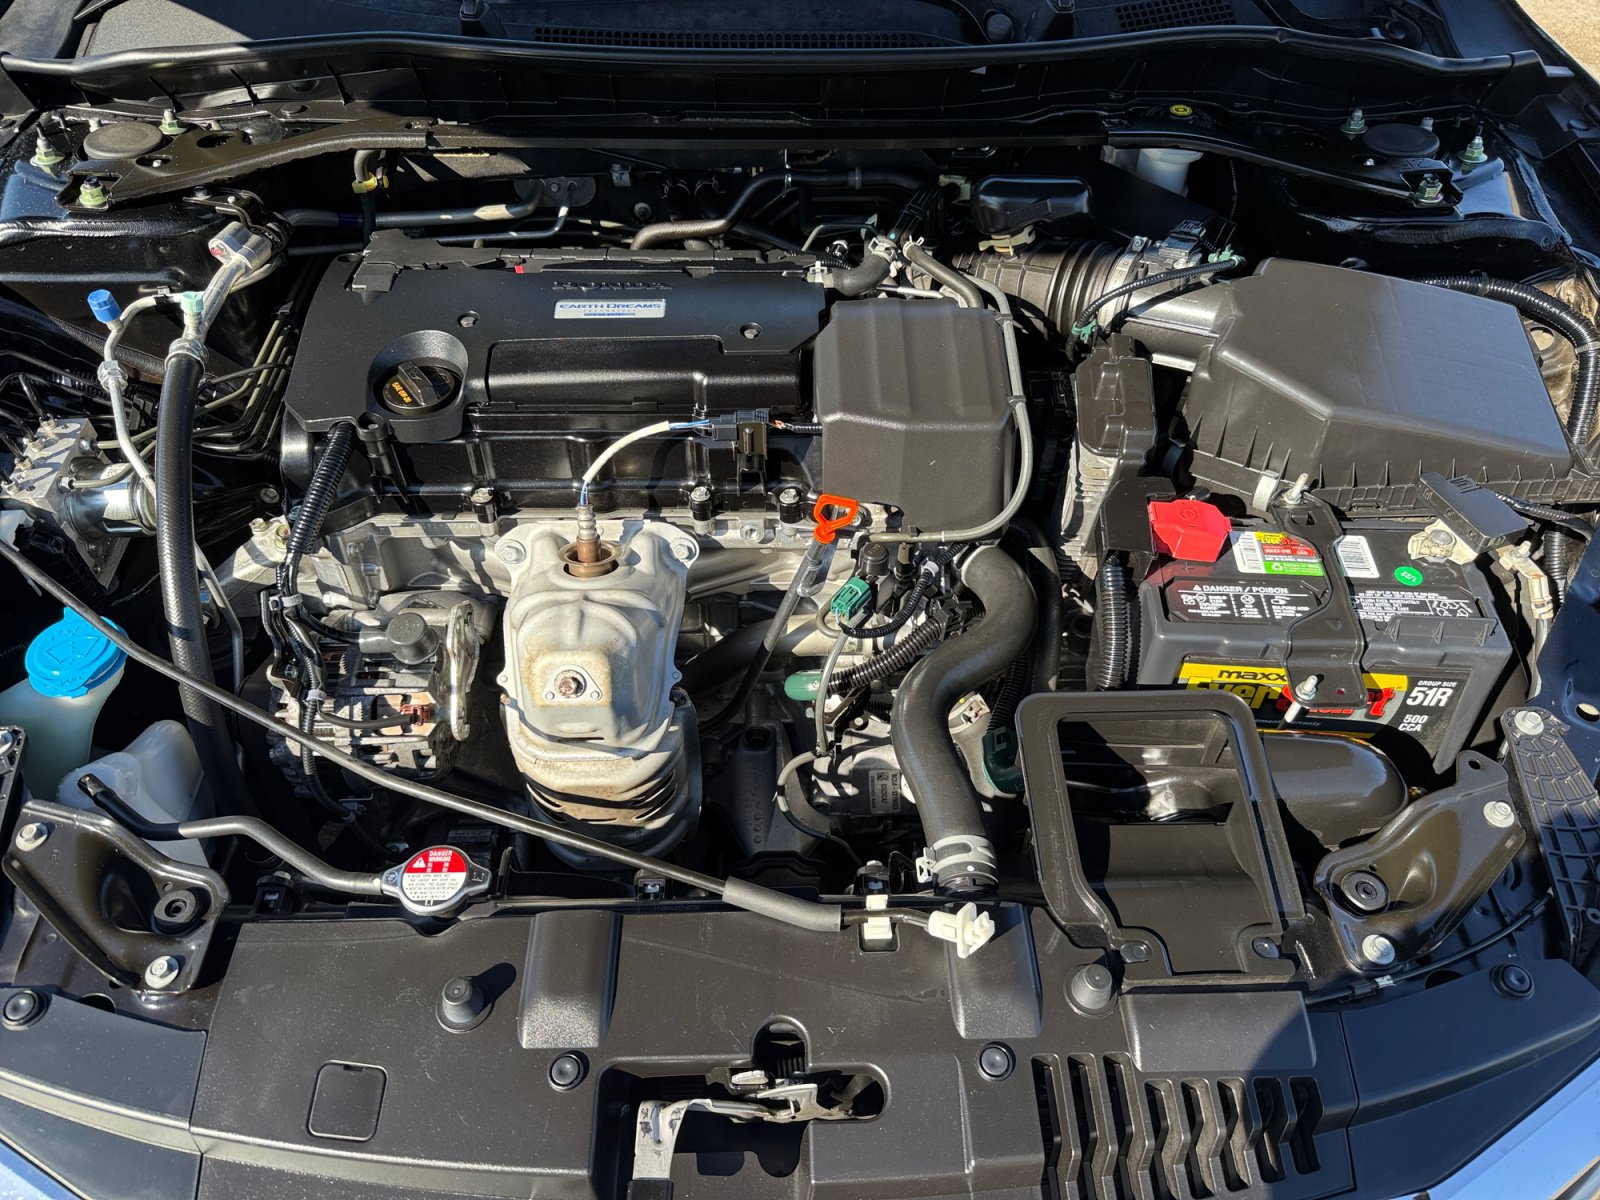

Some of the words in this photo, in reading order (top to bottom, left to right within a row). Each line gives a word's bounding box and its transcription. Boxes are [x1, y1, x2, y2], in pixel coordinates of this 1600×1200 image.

[1202, 585, 1243, 593] DANGER
[1251, 586, 1289, 594] POISON
[1406, 686, 1453, 707] 51R
[1402, 714, 1429, 724] 500
[1398, 723, 1422, 732] CCA
